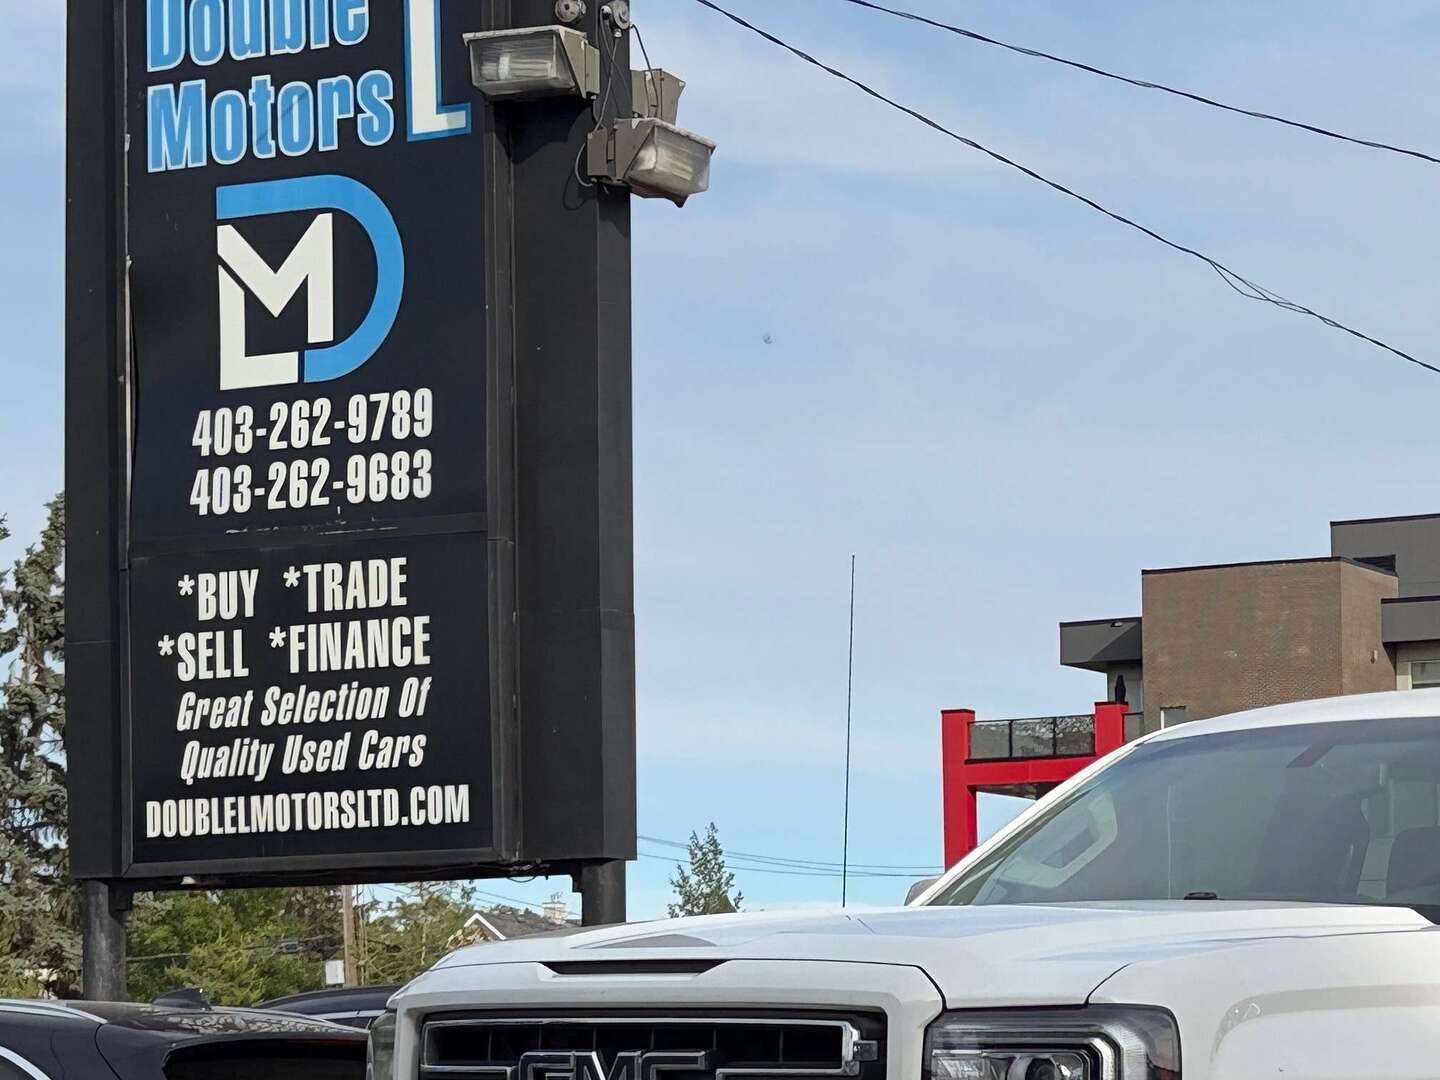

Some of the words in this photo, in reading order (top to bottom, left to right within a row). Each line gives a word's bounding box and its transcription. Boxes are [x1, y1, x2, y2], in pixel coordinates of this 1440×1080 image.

[146, 0, 370, 73] Double
[403, 0, 471, 142] L
[146, 69, 395, 173] Motors
[191, 387, 433, 457] 403-262-9789
[189, 448, 432, 516] 403-262-9683
[176, 691, 255, 732] Great
[260, 682, 390, 726] Selection
[397, 676, 433, 718] Of
[180, 737, 275, 786] Quality
[281, 731, 352, 775] Used
[358, 730, 427, 770] Cars
[146, 784, 470, 838] DOUBLELMOTORSLTD.COM
